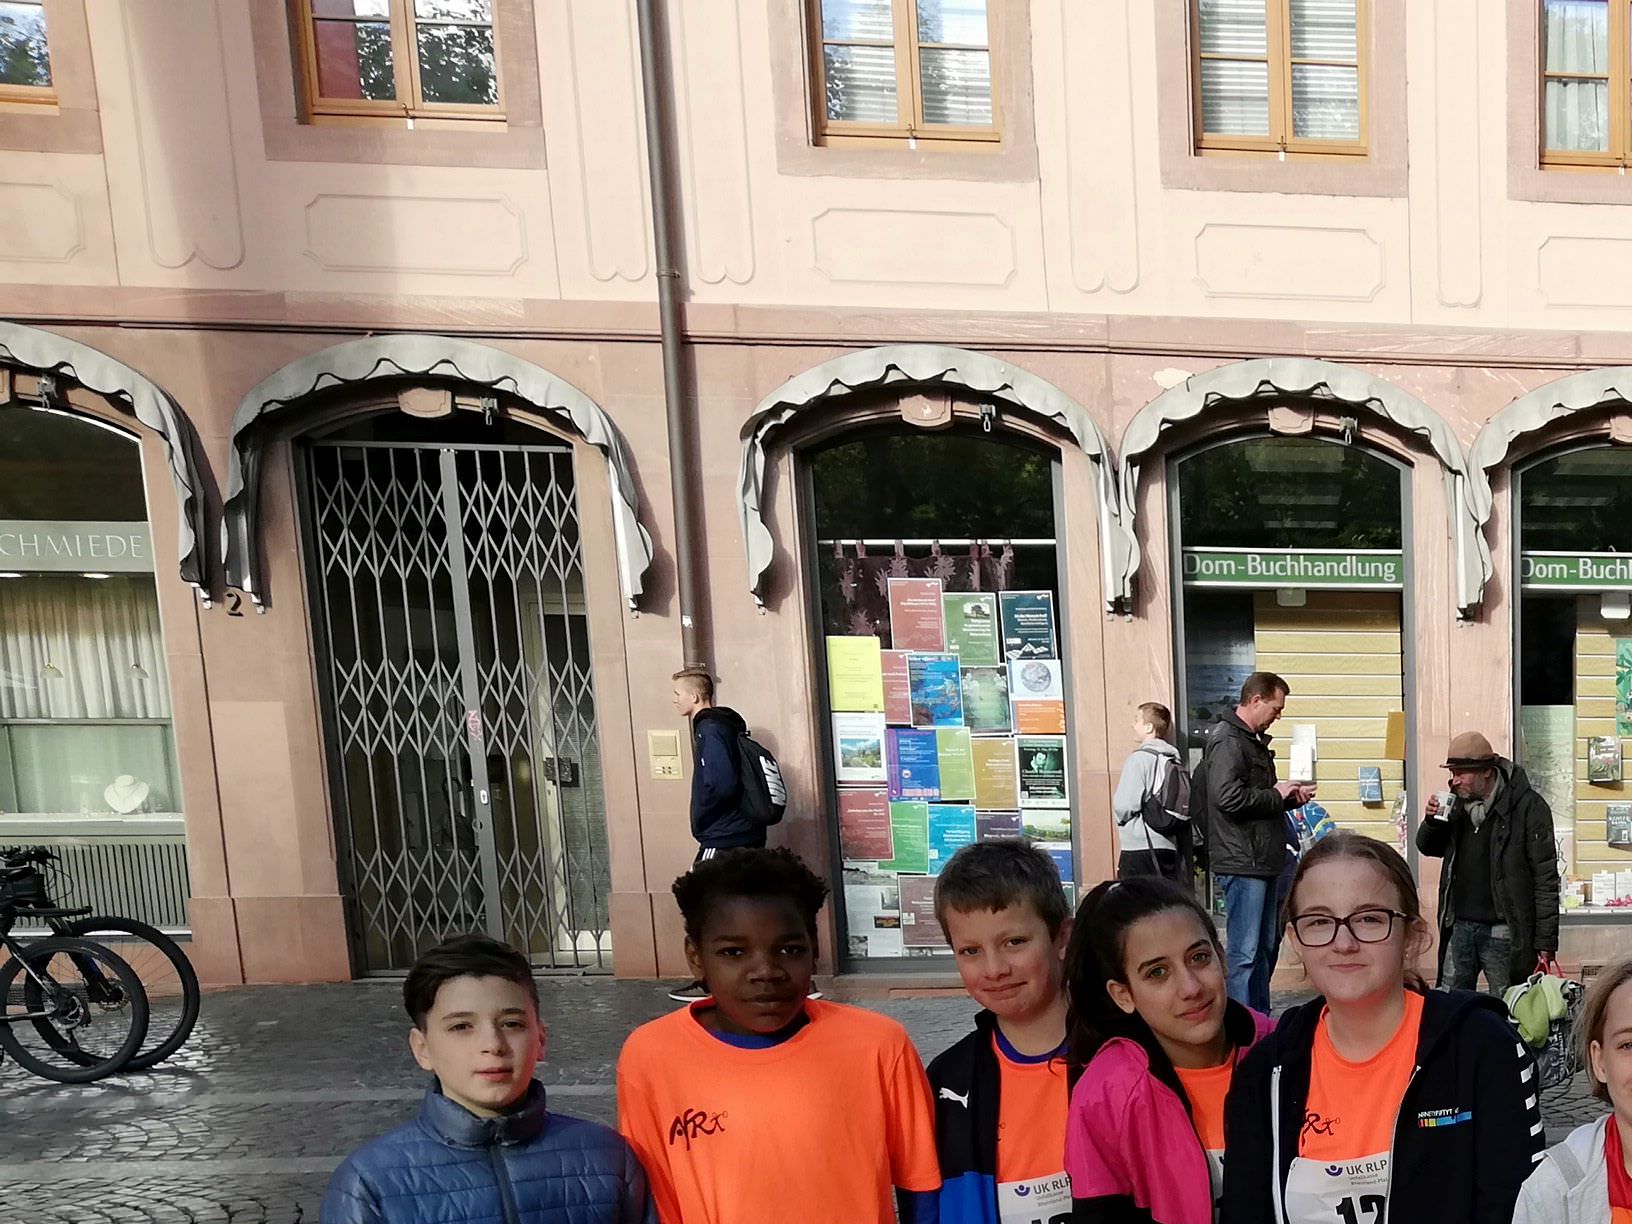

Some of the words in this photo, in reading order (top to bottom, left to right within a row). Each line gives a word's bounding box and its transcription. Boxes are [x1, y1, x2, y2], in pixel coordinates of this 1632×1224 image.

[1183, 553, 1397, 582] Dom-Buchhandlung
[226, 592, 244, 617] 2
[1346, 1164, 1364, 1175] UK
[1366, 1159, 1388, 1172] RLP
[1033, 1184, 1050, 1195] UK
